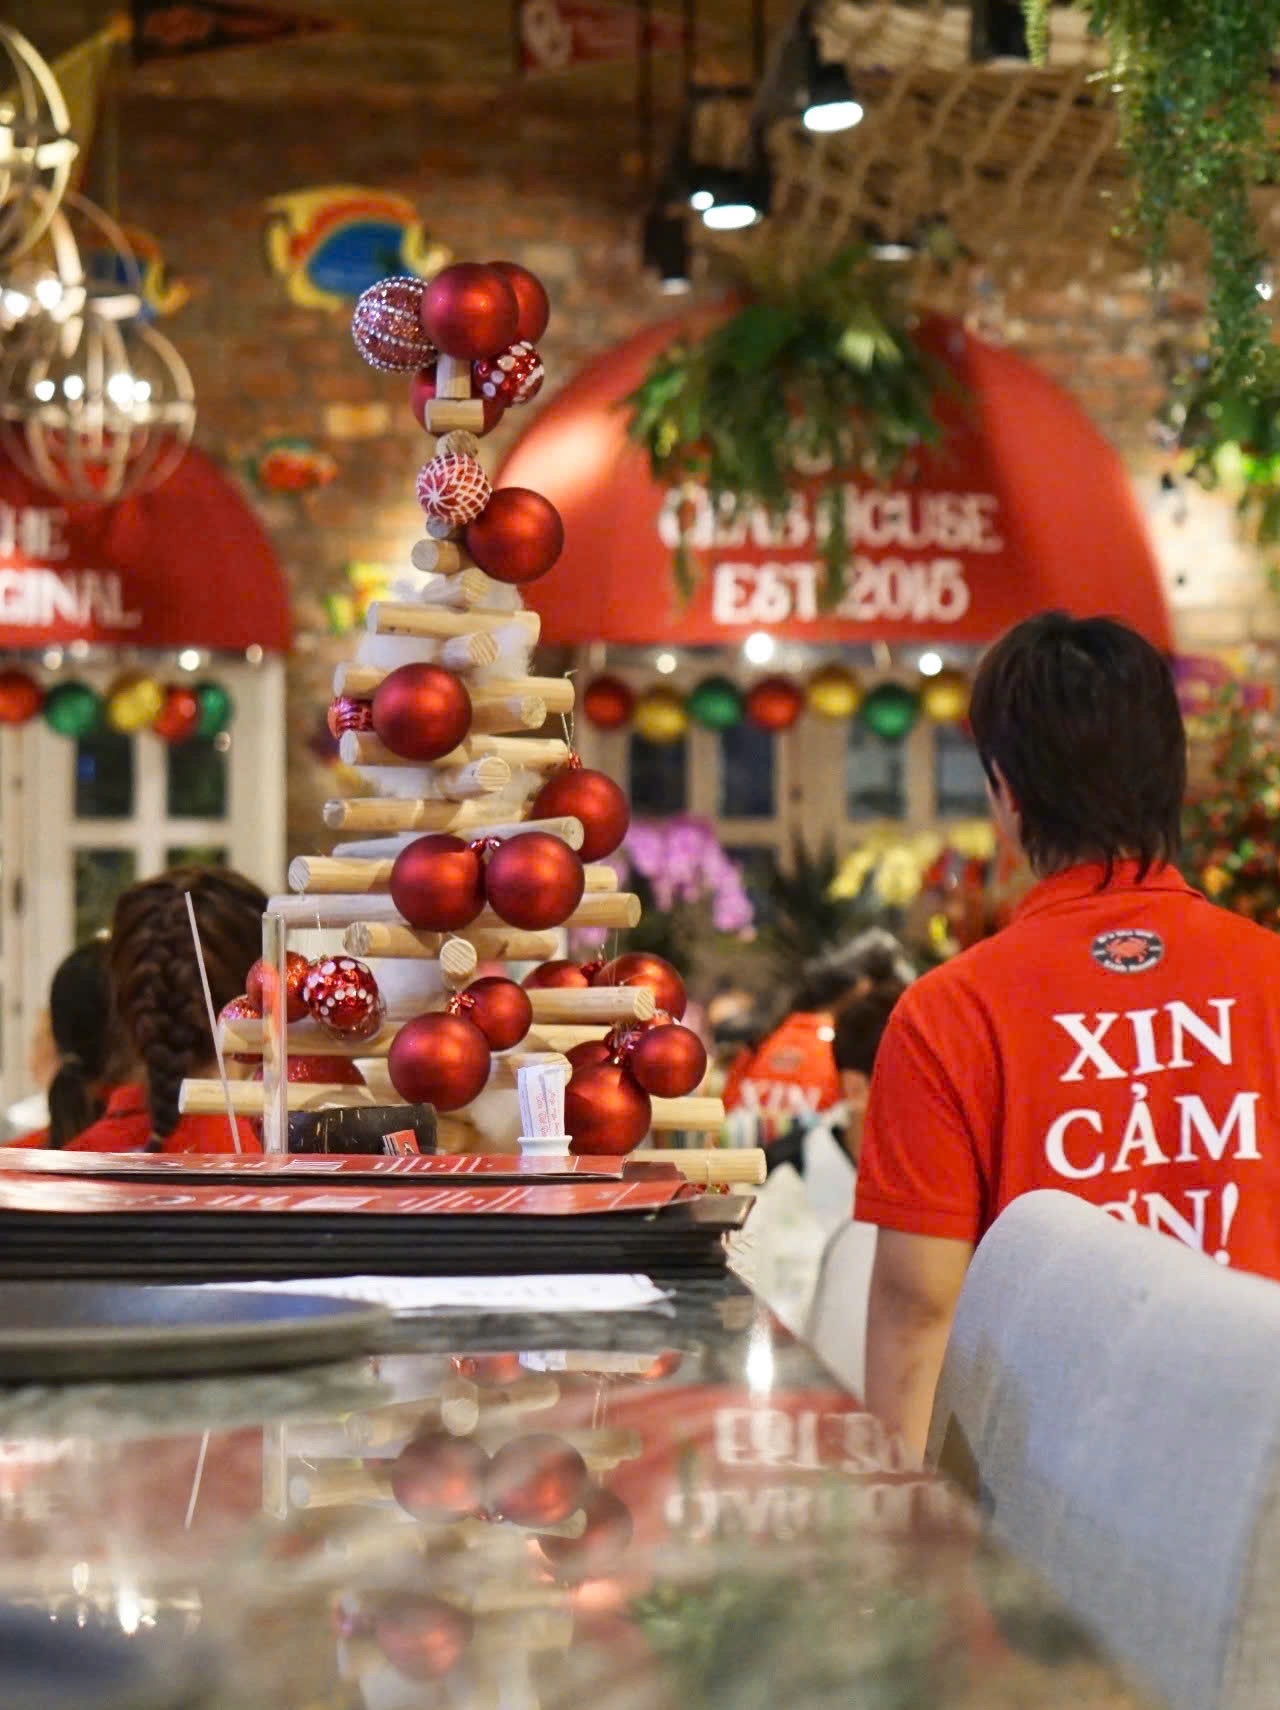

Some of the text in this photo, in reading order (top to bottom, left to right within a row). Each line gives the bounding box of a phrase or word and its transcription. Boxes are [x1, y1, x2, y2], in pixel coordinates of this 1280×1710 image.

[712, 560, 819, 624] EST
[1052, 997, 1237, 1082] XIN
[1044, 1082, 1262, 1180] CẢM
